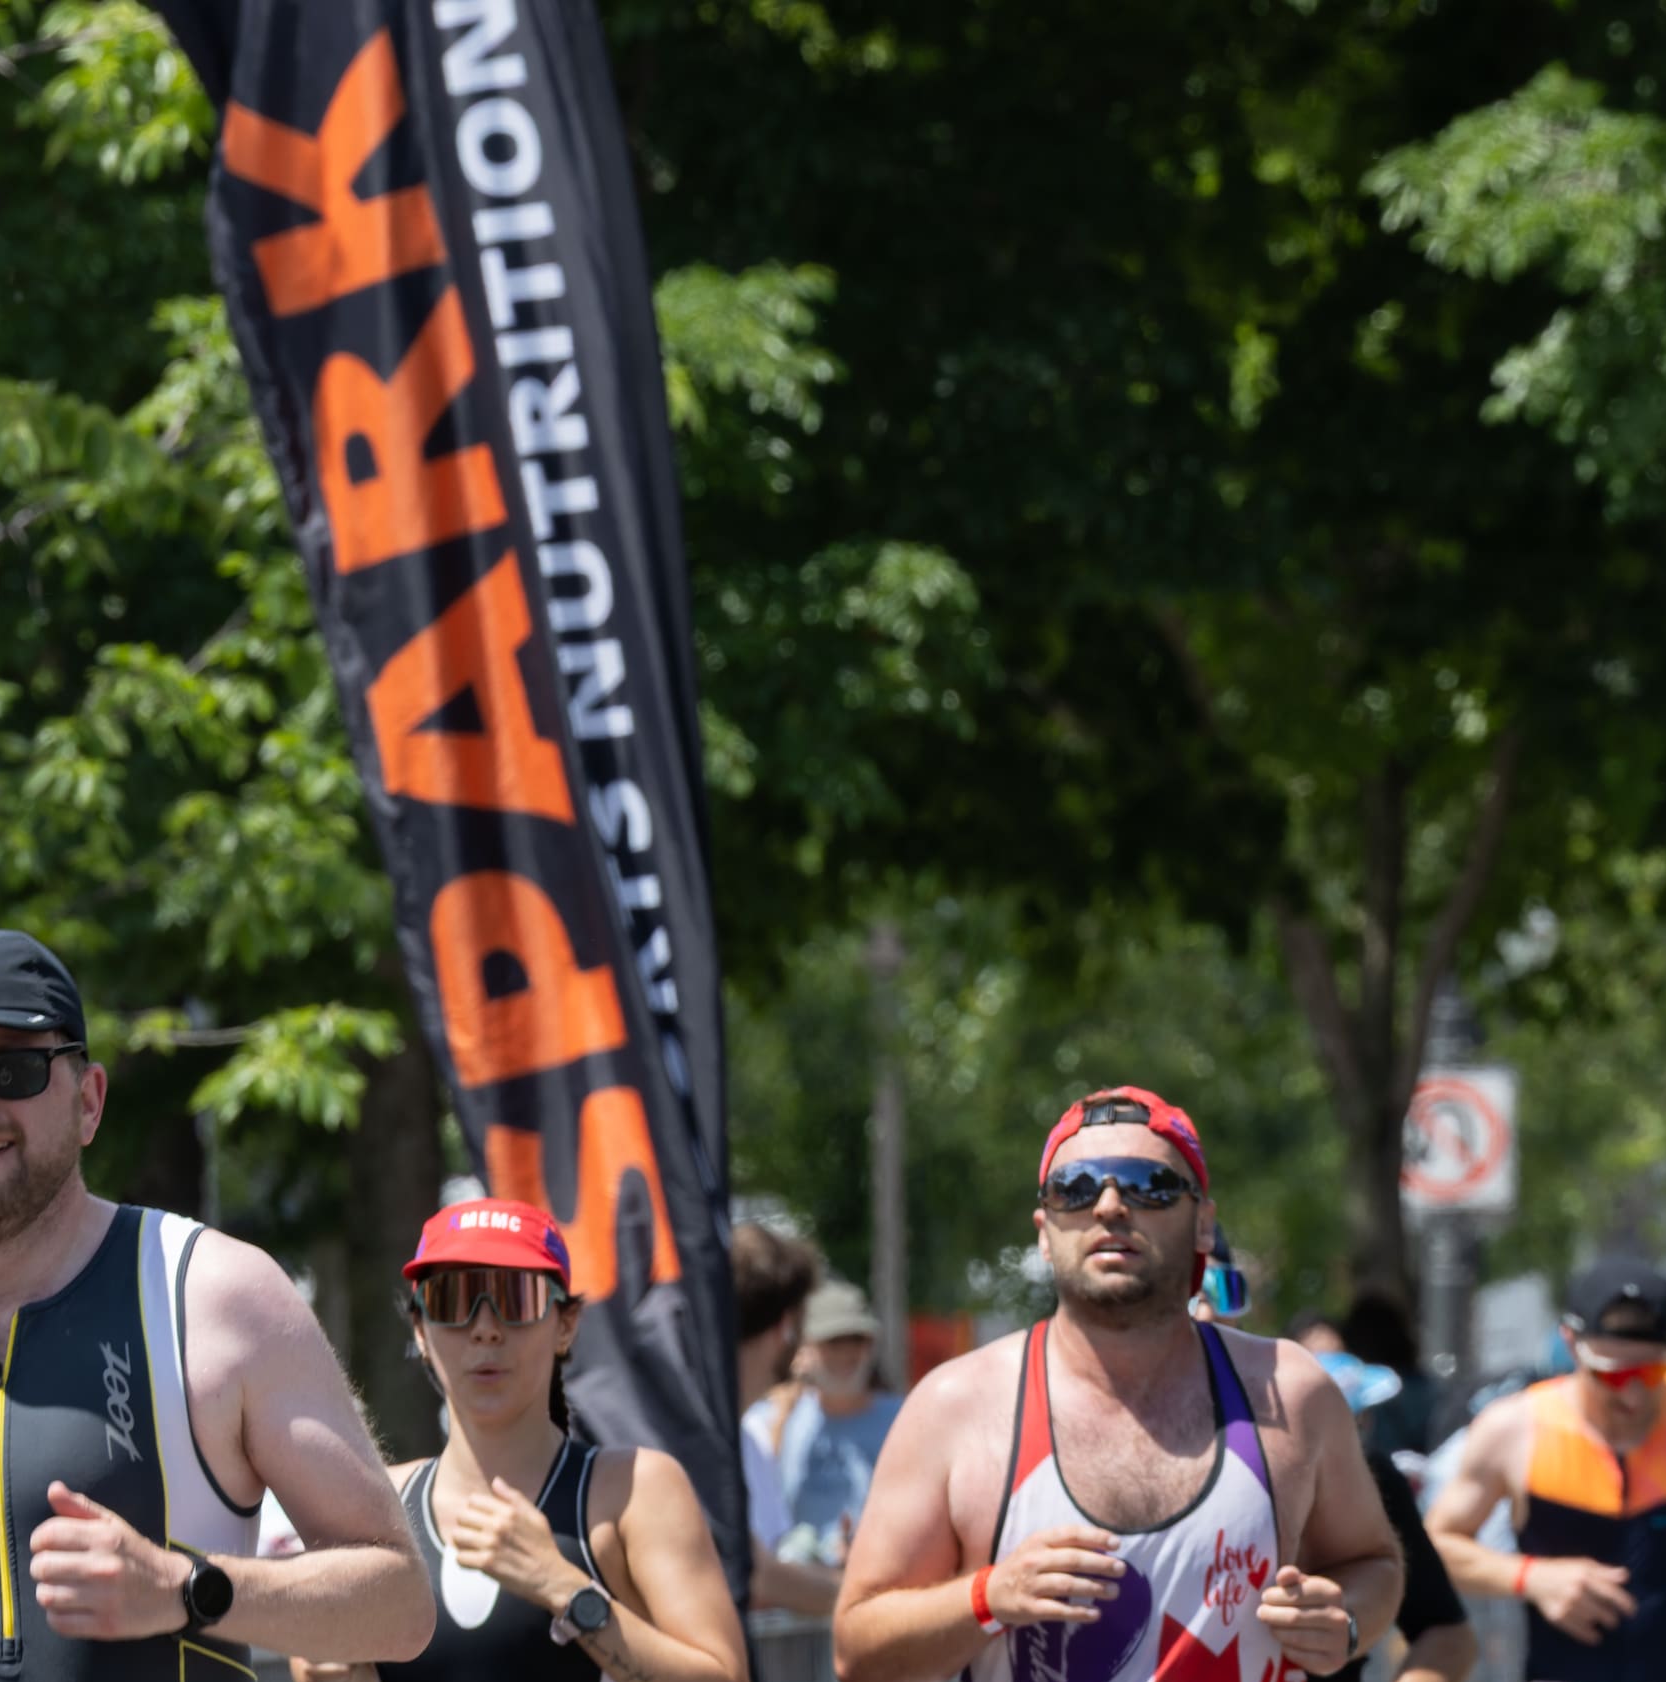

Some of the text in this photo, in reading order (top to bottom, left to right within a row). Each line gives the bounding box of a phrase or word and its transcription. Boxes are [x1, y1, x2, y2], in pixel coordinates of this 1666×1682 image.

[433, 0, 635, 740] NUTRITION
[222, 26, 682, 1302] SPARK
[1203, 1564, 1248, 1625] life
[1215, 1529, 1260, 1575] love
